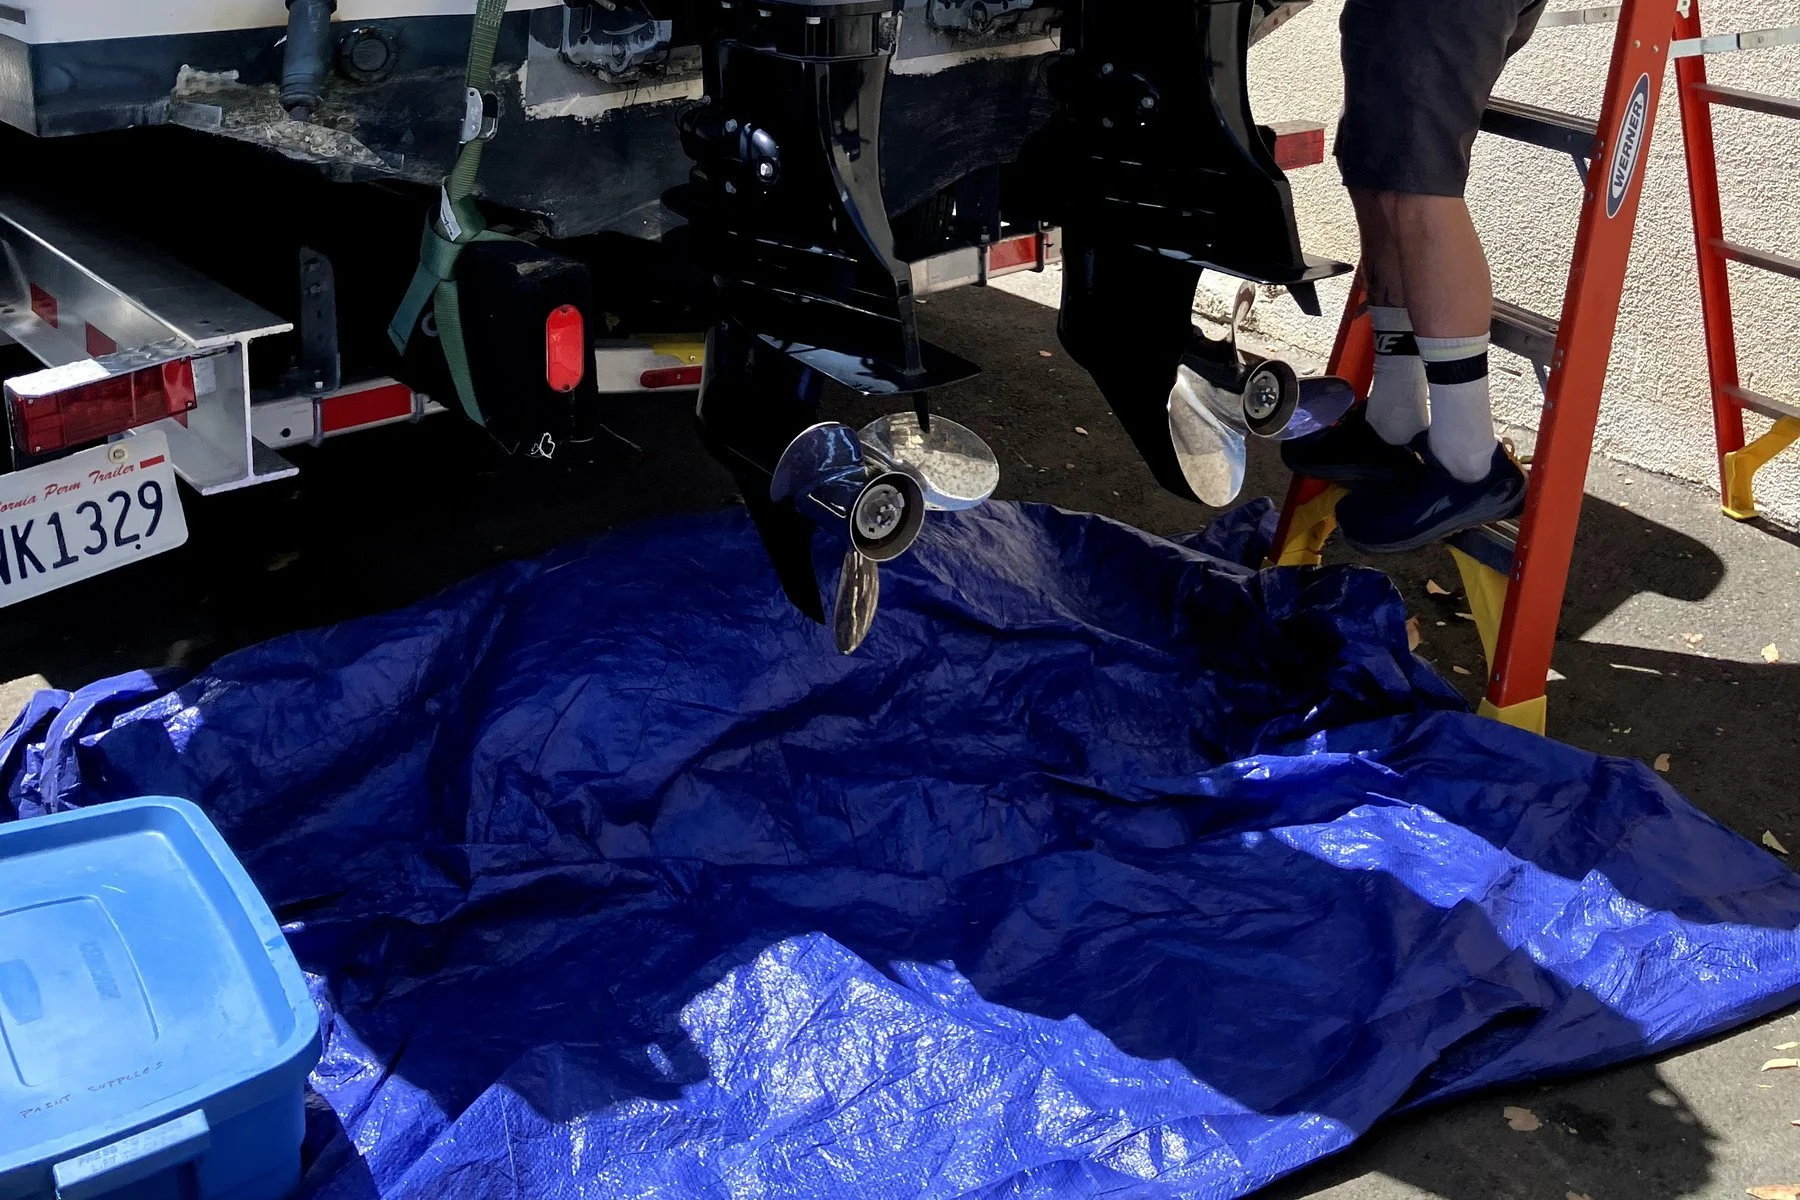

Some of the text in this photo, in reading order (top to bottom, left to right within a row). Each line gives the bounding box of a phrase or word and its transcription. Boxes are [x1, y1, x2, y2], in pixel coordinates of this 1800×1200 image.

[1613, 101, 1643, 188] WERNER
[0, 464, 135, 512] ornia Perm Trailer
